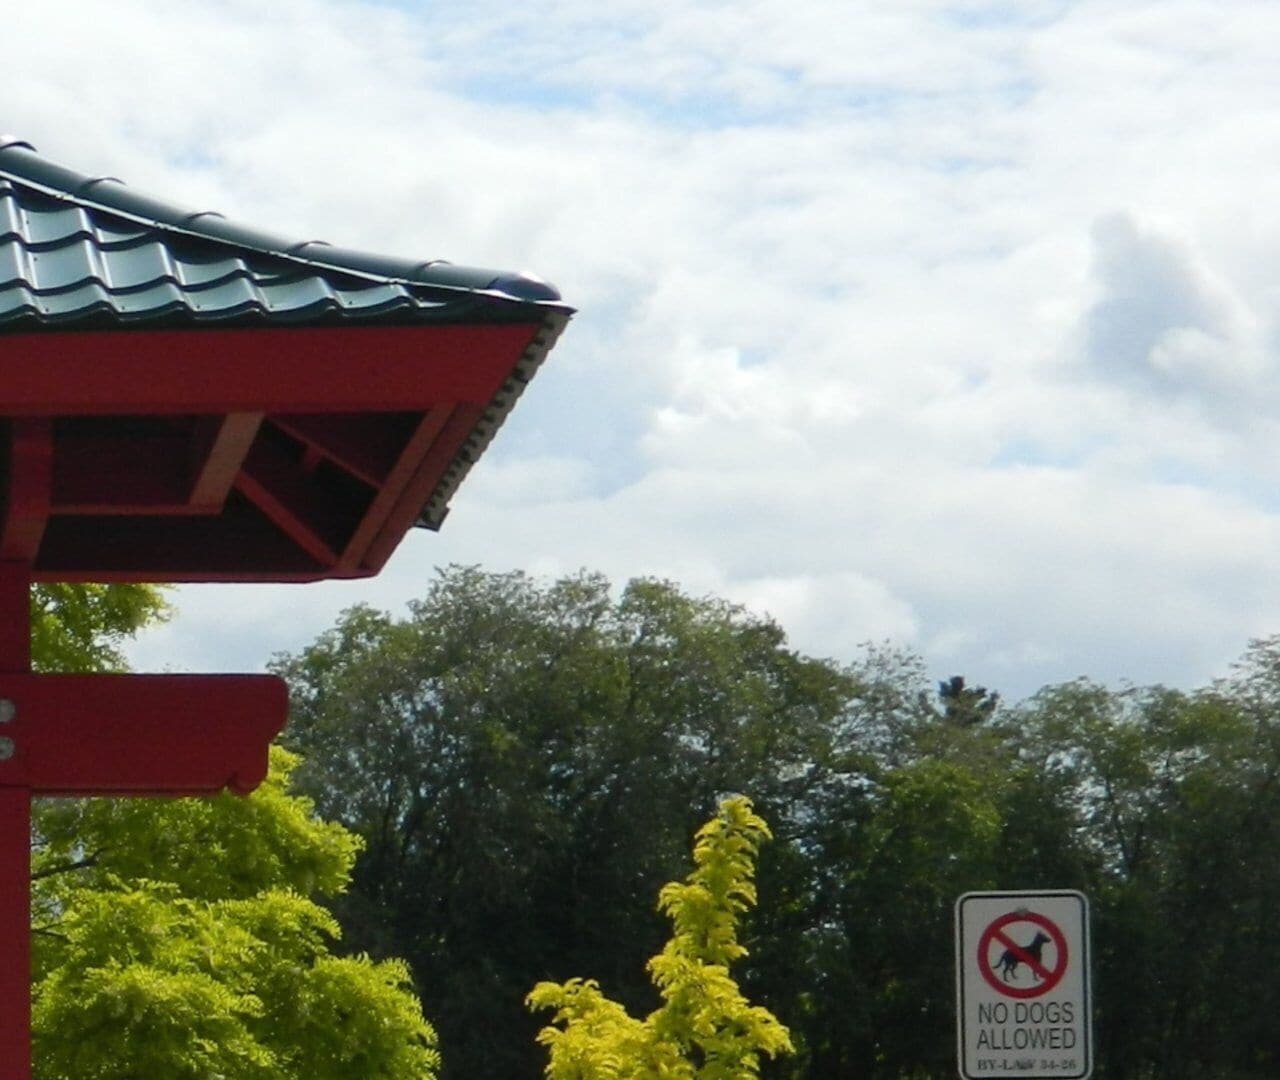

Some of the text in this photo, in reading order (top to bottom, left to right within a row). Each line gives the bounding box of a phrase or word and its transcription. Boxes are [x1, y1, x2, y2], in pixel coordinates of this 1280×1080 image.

[978, 1001, 1074, 1024] NO DOGS
[977, 1027, 1076, 1050] ALLOWED
